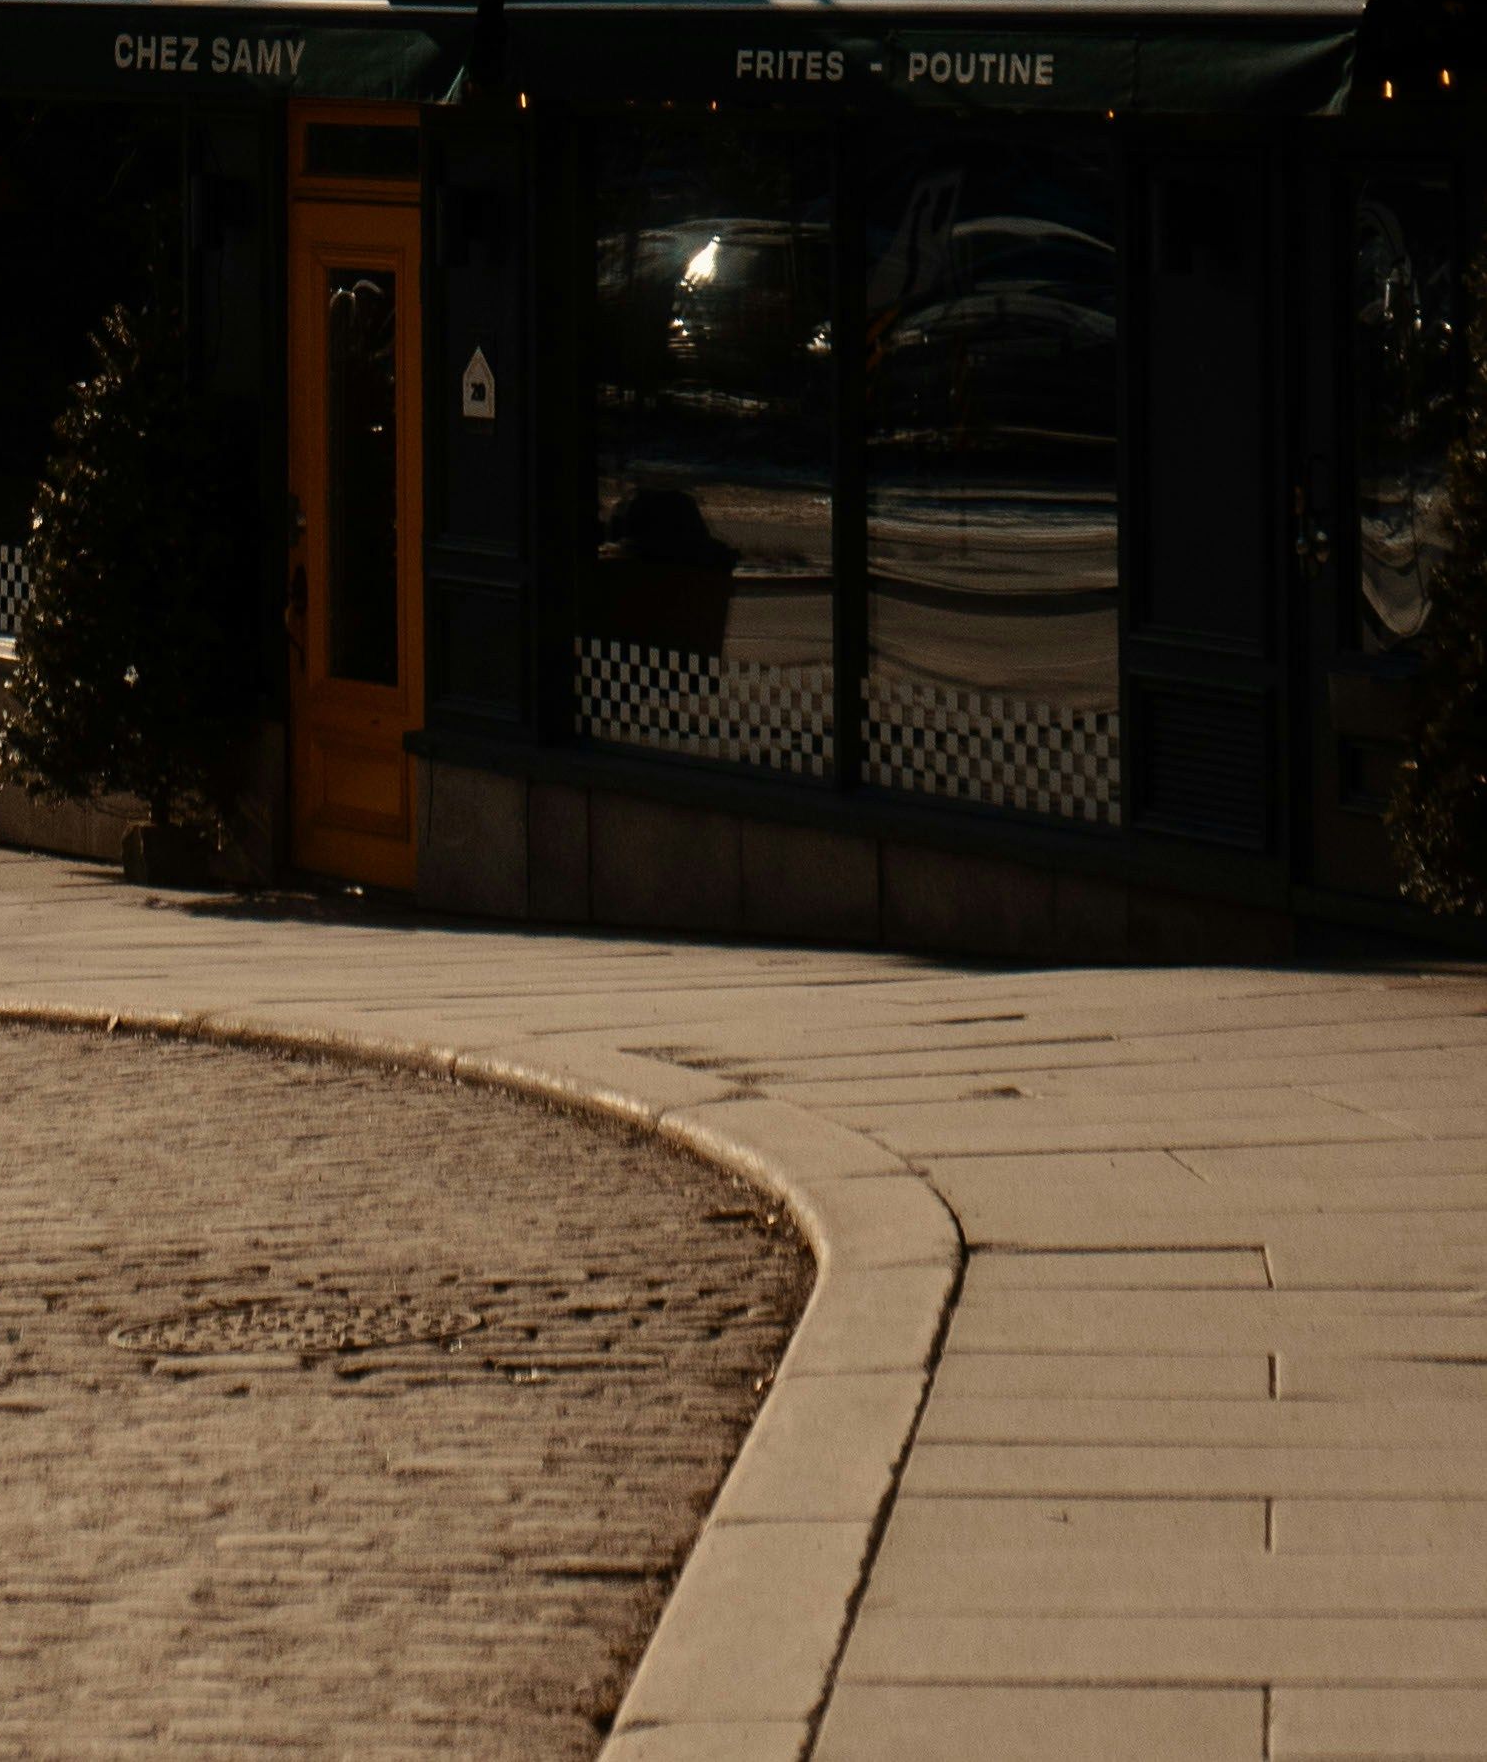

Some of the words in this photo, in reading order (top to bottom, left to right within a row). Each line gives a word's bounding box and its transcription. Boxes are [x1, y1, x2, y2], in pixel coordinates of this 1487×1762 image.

[115, 32, 200, 72] CHEZ
[211, 36, 306, 76] SAMY
[735, 49, 845, 82] FRITES
[907, 51, 1054, 86] POUTINE
